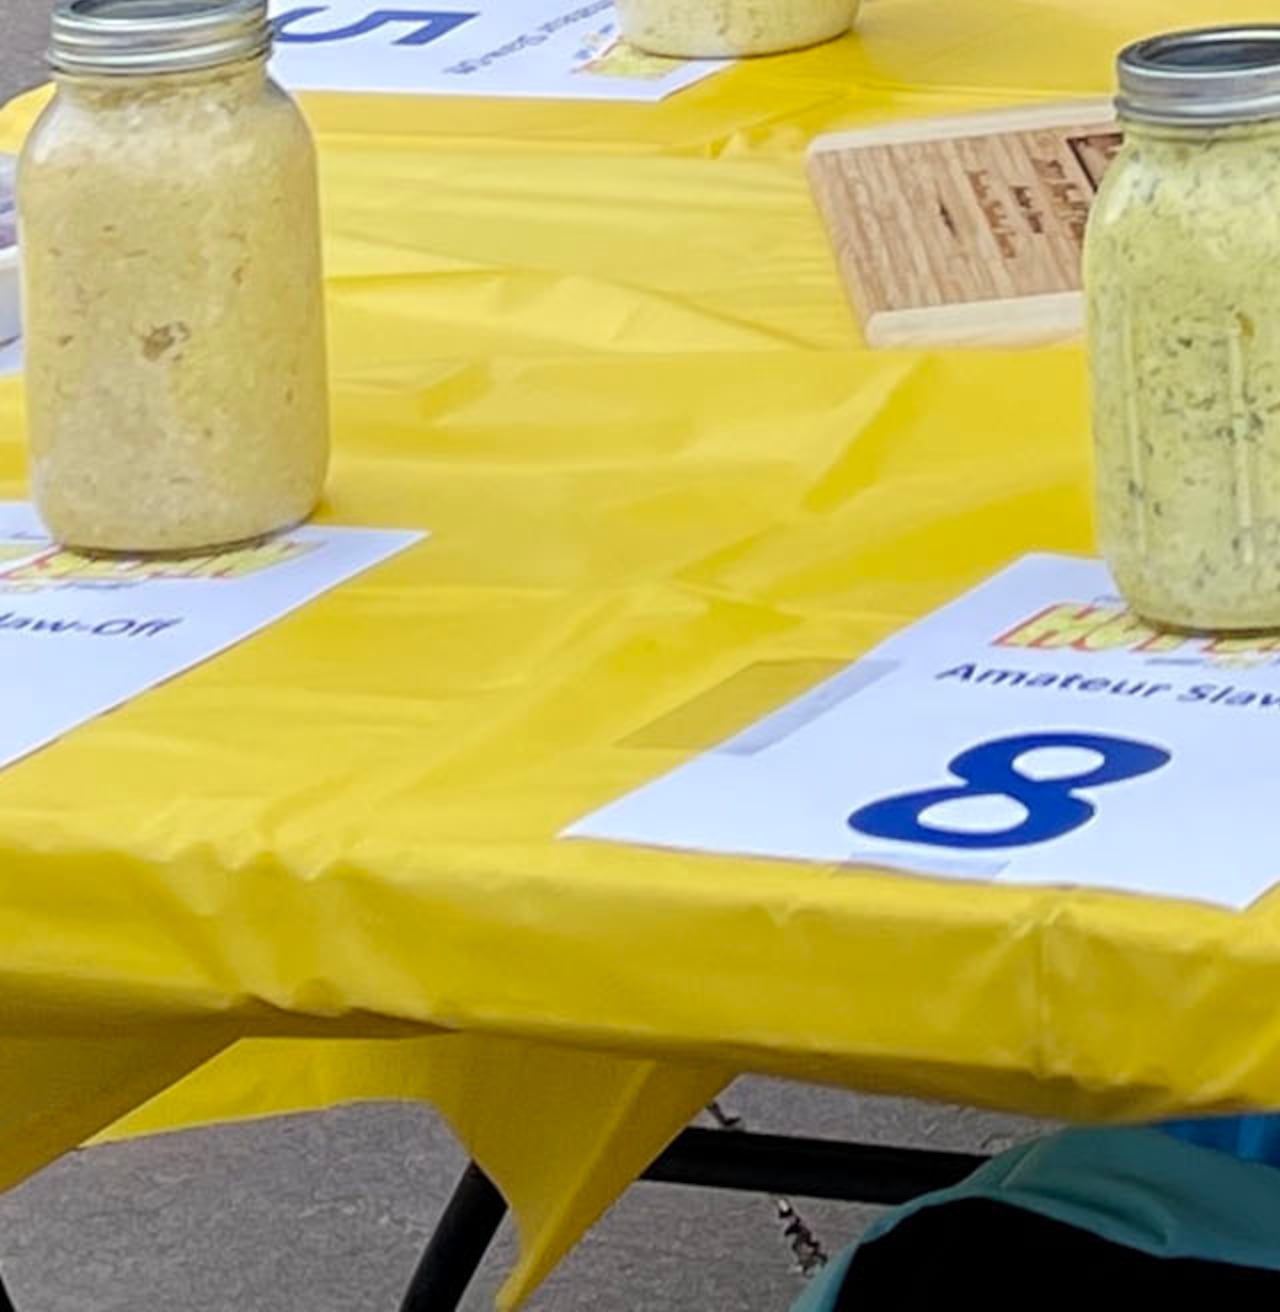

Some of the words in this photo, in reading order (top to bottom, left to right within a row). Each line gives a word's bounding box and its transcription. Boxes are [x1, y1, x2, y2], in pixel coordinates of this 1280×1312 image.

[273, 5, 482, 44] 5
[0, 610, 184, 639] law-Off
[936, 662, 1170, 699] Amateur
[848, 731, 1172, 850] 8
